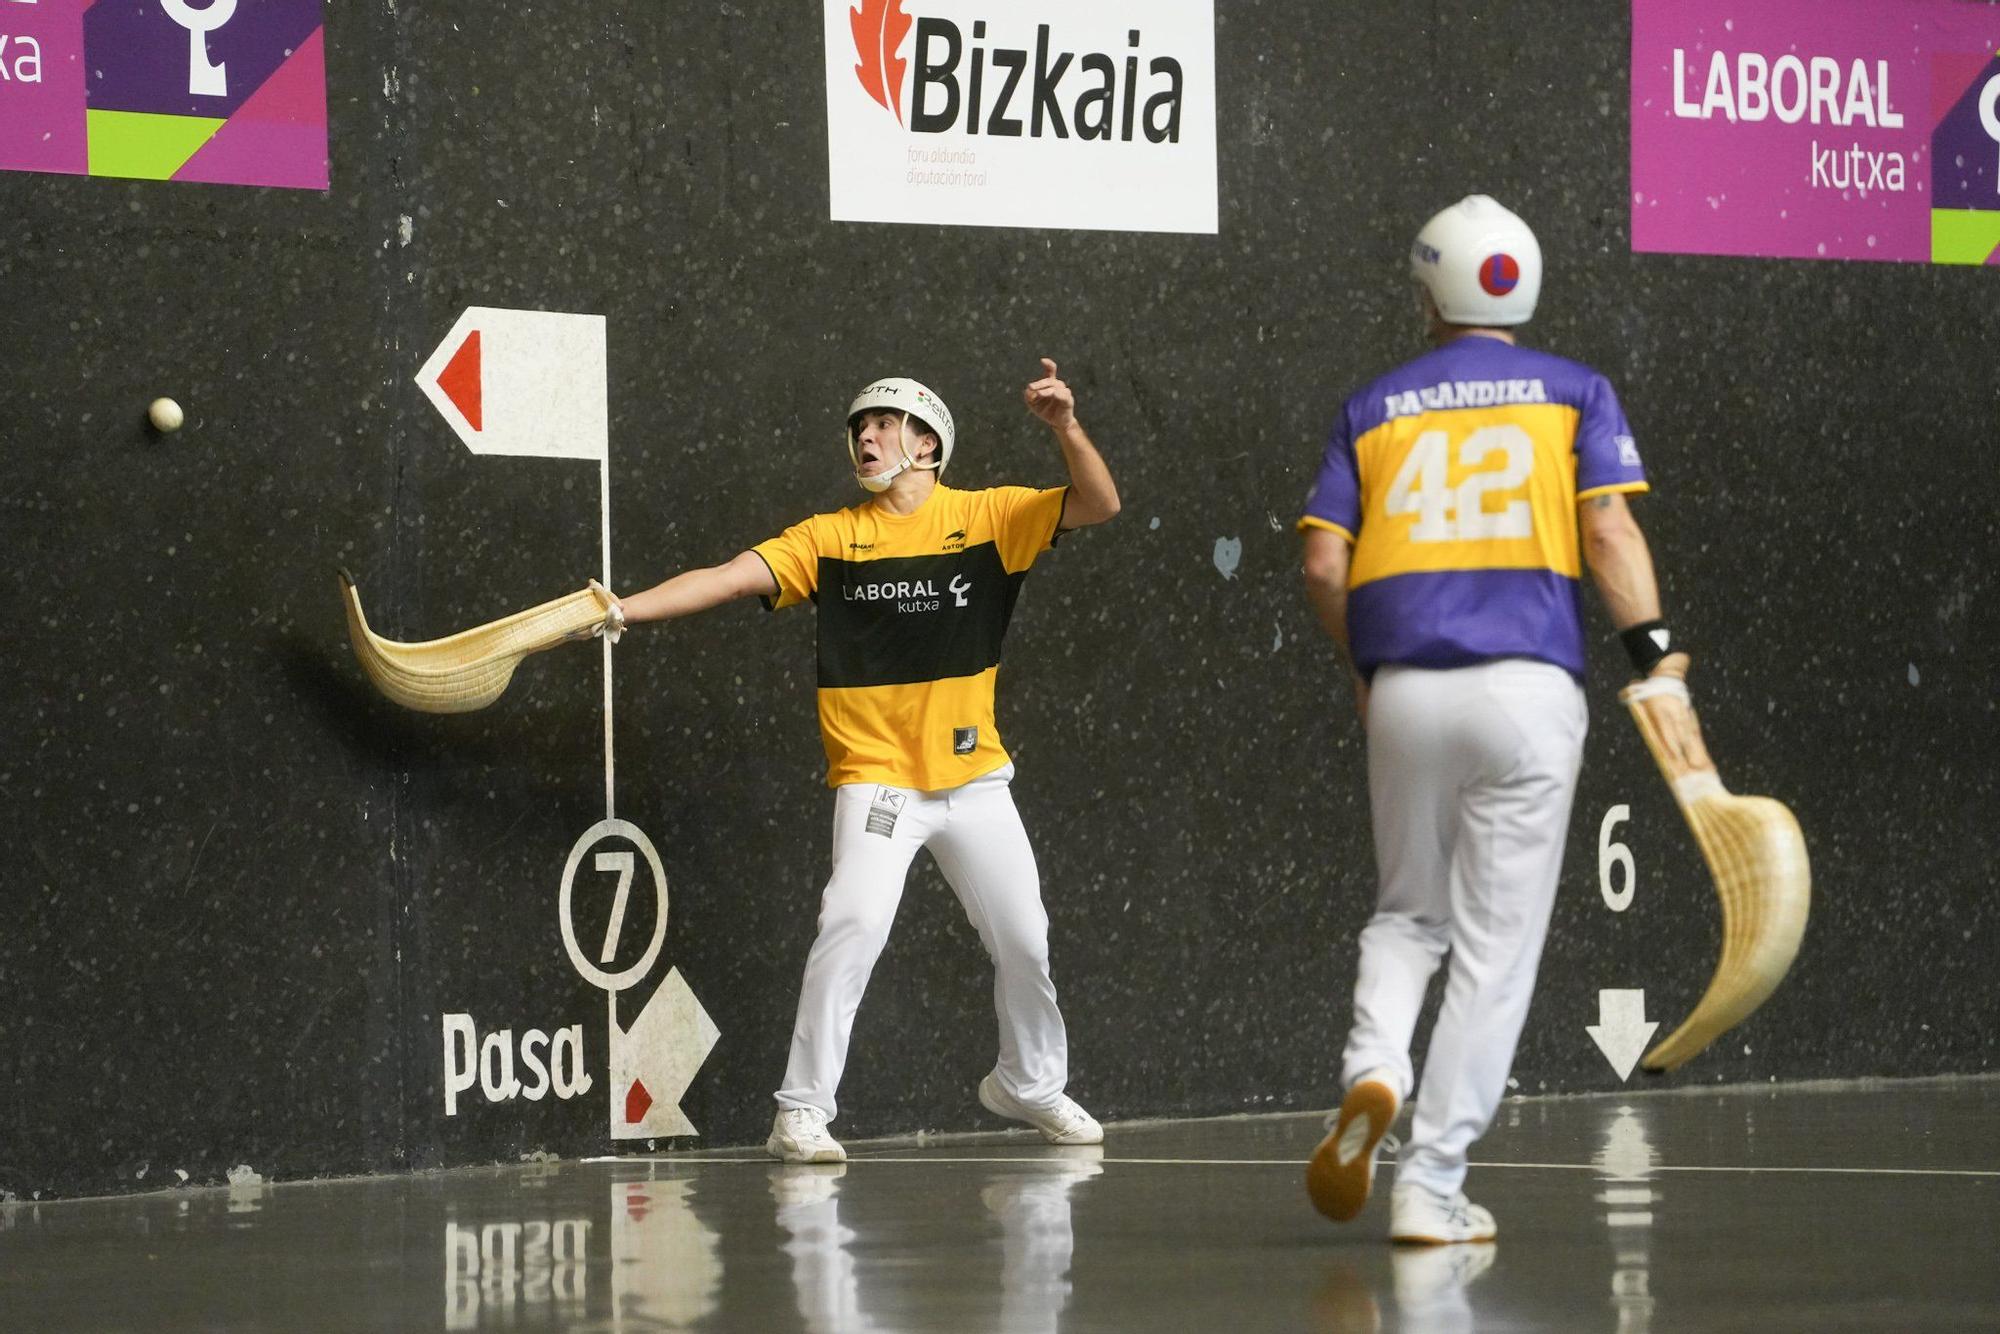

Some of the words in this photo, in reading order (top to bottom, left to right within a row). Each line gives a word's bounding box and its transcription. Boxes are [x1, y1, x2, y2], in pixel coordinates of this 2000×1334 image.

[911, 17, 1183, 144] Bizkaia
[1673, 48, 1904, 129] LABORAL
[1812, 140, 1905, 191] kutxa
[1384, 424, 1534, 543] 42
[843, 579, 940, 601] LABORAL
[898, 599, 940, 614] kutxa
[595, 851, 635, 964] 7
[1598, 804, 1636, 912] 6
[442, 1012, 593, 1116] Pasa
